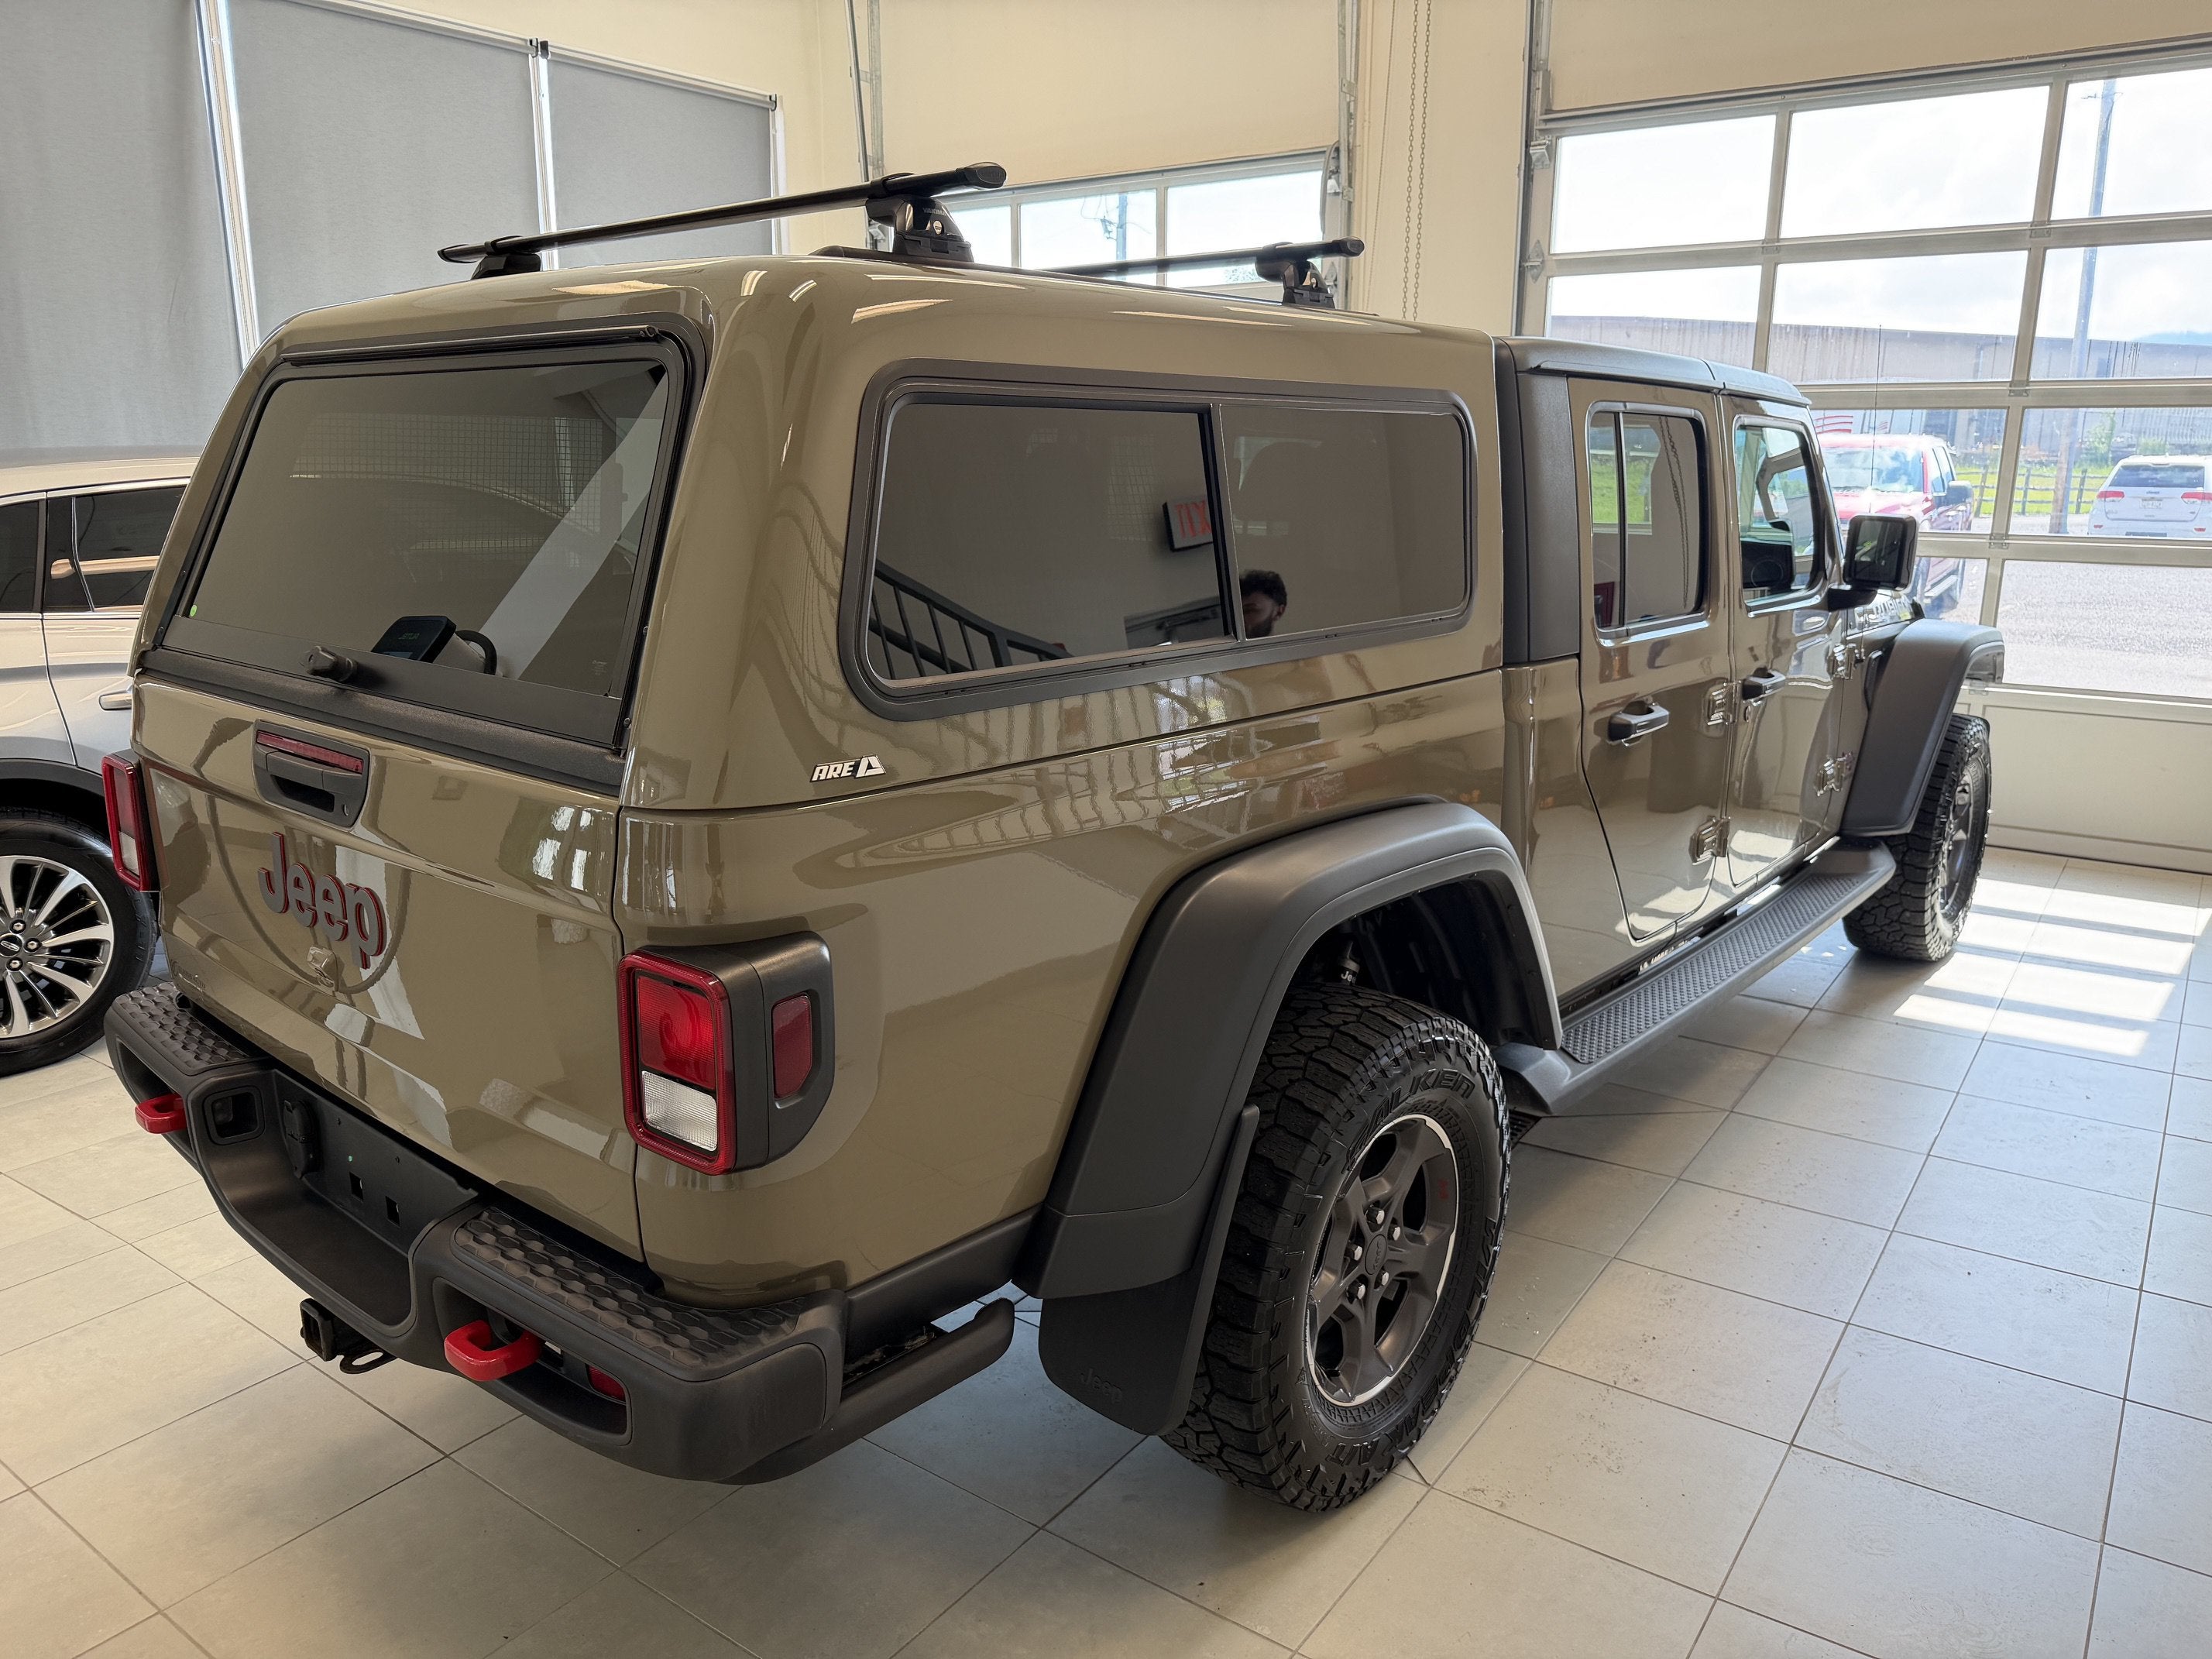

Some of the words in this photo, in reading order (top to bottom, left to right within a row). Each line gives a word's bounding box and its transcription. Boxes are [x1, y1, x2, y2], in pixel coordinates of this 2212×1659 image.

[811, 761, 855, 781] ARE
[257, 831, 387, 970] Jeep
[1341, 970, 1357, 985] Jee
[1080, 1367, 1123, 1405] Jeep
